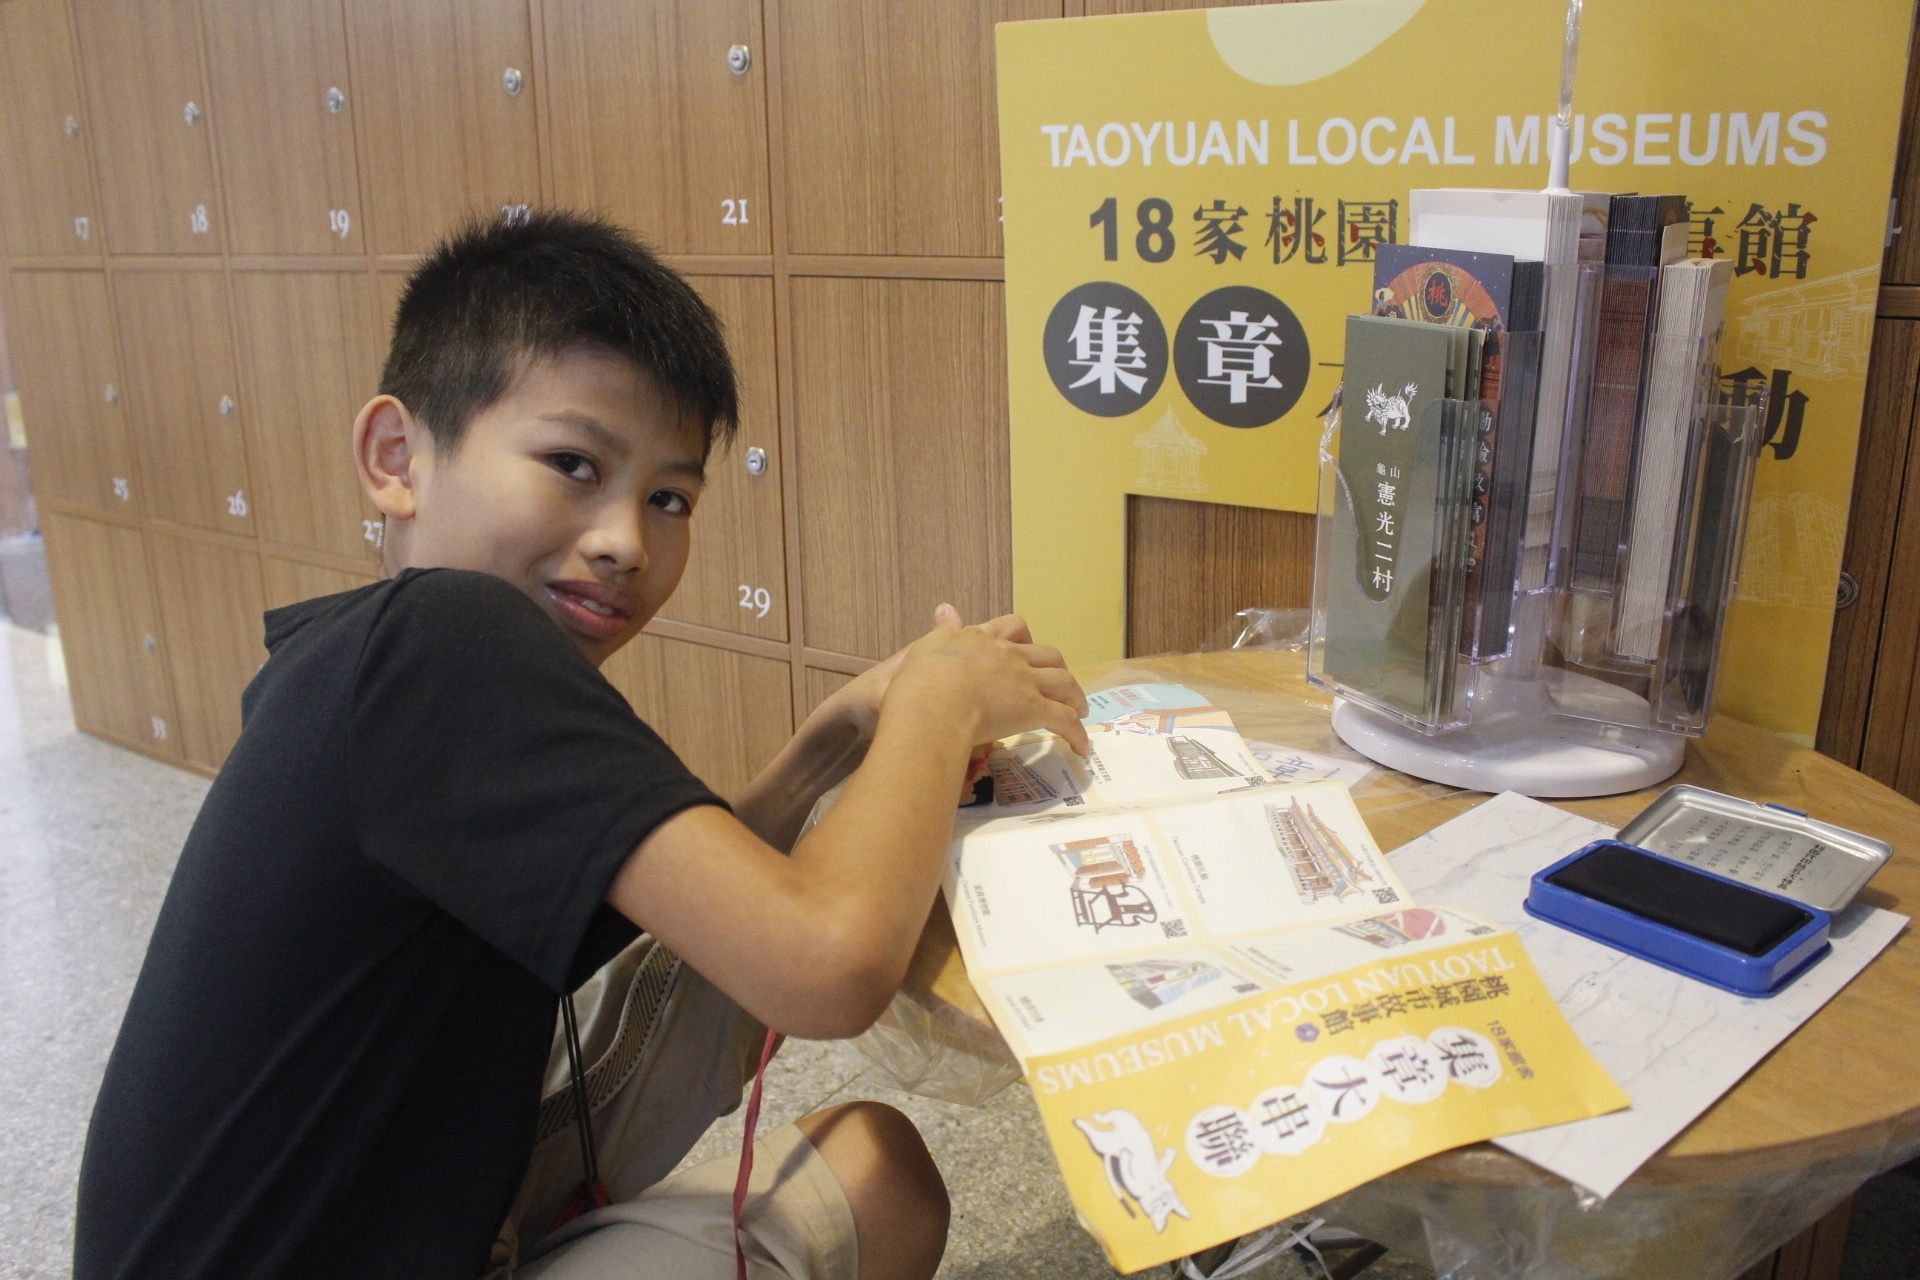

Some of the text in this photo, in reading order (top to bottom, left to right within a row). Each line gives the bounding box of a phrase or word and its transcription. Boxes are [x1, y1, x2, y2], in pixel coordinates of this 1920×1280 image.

[1041, 110, 1829, 168] TAOYUAN LOCAL MUSEUMS
[191, 204, 207, 233] 18
[329, 210, 350, 238] 19
[721, 199, 749, 226] 21
[227, 490, 249, 517] 26
[362, 520, 384, 548] 27
[1371, 481, 1396, 593] 憲光二村
[737, 584, 771, 618] 29
[1352, 945, 1515, 999] TAOYUAN
[1227, 981, 1350, 1038] LOCAL
[1036, 1020, 1227, 1095] MUSEUMS
